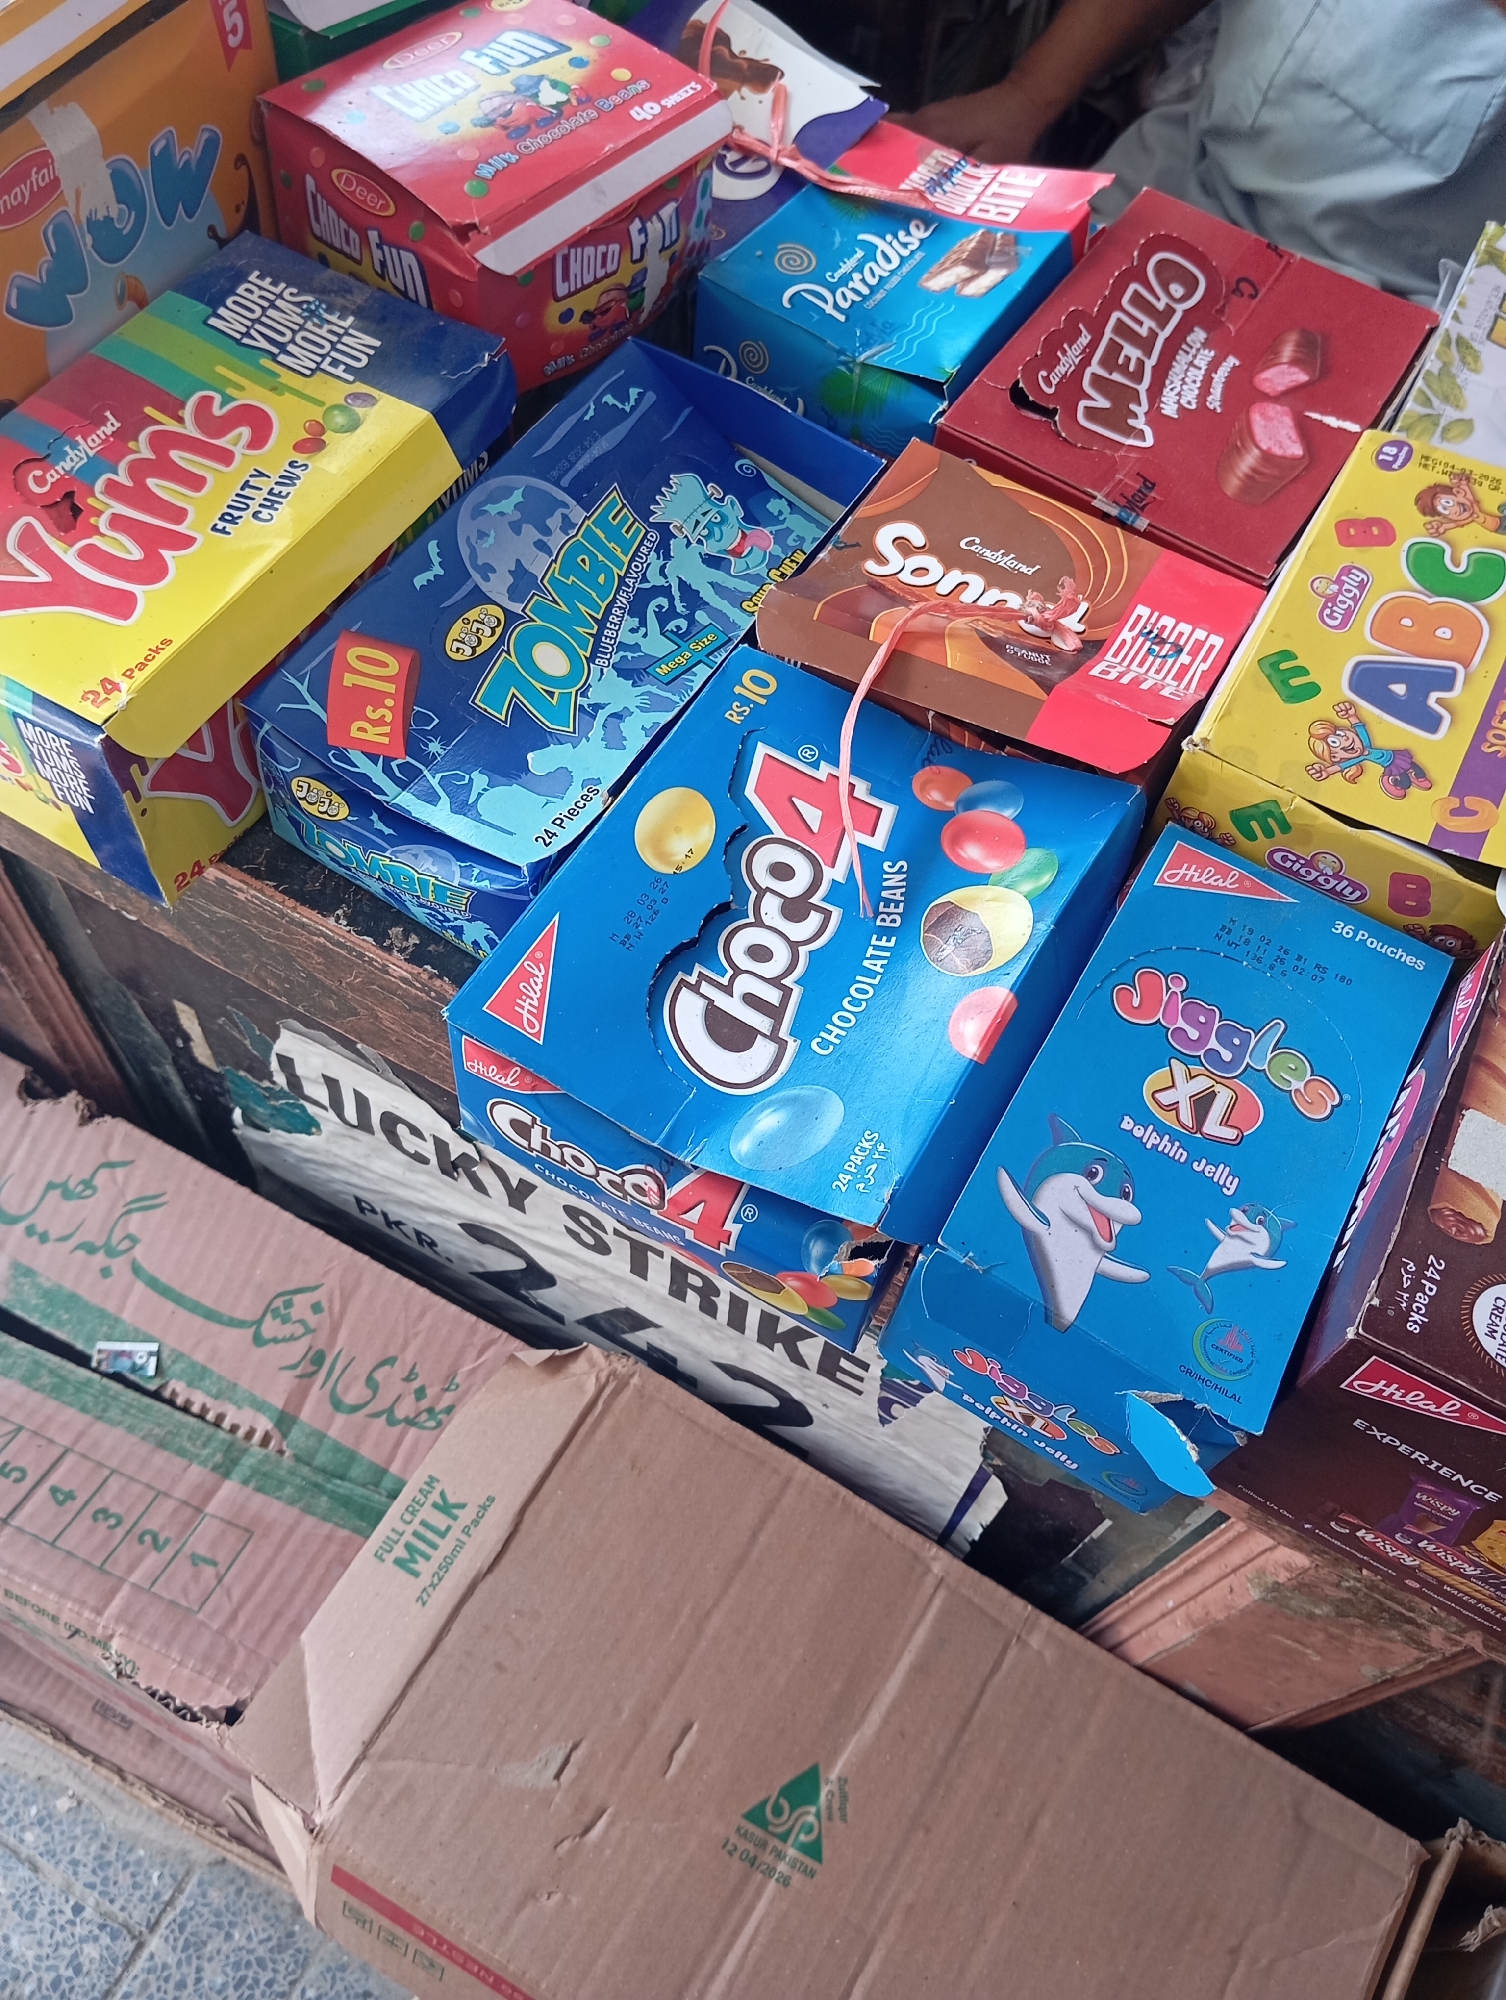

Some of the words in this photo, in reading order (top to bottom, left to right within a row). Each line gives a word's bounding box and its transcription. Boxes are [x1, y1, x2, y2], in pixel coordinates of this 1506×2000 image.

[475, 151, 519, 180] Milk
[516, 108, 599, 155] Chocolate
[594, 79, 651, 112] Beans
[629, 101, 662, 122] 40
[337, 172, 392, 213] Deer
[966, 168, 1048, 224] BITE
[5, 125, 222, 330] WOW
[305, 173, 363, 266] CHOCO
[366, 229, 432, 308] FUN
[554, 242, 622, 300] CHOCO
[782, 219, 939, 323] Paradise
[207, 270, 287, 340] MORE
[242, 287, 314, 356] YUMS
[277, 310, 355, 377] MORE
[321, 329, 382, 382] FUN
[1077, 251, 1206, 448] MELLO
[1378, 445, 1398, 462] 18
[0, 391, 279, 626] Yums
[211, 467, 272, 537] FRUITY
[251, 459, 310, 524] CHEWS
[1333, 516, 1397, 548] B
[470, 484, 650, 735] ZOMBIE
[594, 597, 630, 670] BLUEBERRY
[617, 529, 660, 606] FLAVOURED
[1322, 565, 1369, 628] Giggly
[654, 645, 694, 678] Mega
[690, 630, 718, 657] Size
[1103, 603, 1226, 693] BIGGER
[1342, 536, 1506, 741] ABC
[80, 676, 124, 710] 24
[120, 635, 174, 682] Packs
[343, 645, 401, 746] Rs.10
[1088, 662, 1187, 701] BITE
[1257, 648, 1322, 705] E
[16, 717, 73, 753] MORE
[27, 742, 83, 778] YUMS
[33, 758, 96, 801] MORE
[52, 782, 95, 815] FUN
[534, 822, 559, 850] 24
[554, 784, 601, 829] Pieces
[1229, 799, 1293, 842] E
[1431, 796, 1501, 834] C
[174, 859, 206, 893] 24
[300, 818, 477, 912] ZOMBIE
[1162, 861, 1241, 890] Hilal
[1272, 849, 1365, 906] Giggly
[619, 933, 632, 948] BB
[632, 915, 644, 930] 27
[646, 899, 658, 911] 03
[658, 880, 670, 895] 27
[623, 910, 637, 925] 28
[637, 893, 650, 906] 03
[649, 876, 663, 891] 26
[644, 908, 660, 926] 126
[1386, 872, 1434, 918] B
[809, 931, 899, 1057] CHOCOLATE
[876, 858, 908, 931] BEANS
[1218, 923, 1233, 937] BB
[1237, 934, 1251, 947] 18
[1256, 945, 1268, 956] 11
[1272, 954, 1286, 966] 26
[1292, 964, 1326, 985] 02:07
[1259, 934, 1272, 947] 02
[1277, 945, 1290, 957] 26
[1313, 962, 1329, 975] RS
[1333, 972, 1353, 986] 180
[1331, 920, 1354, 939] 36
[1354, 929, 1427, 972] Pouches
[514, 958, 547, 1037] Hilal
[465, 1056, 521, 1089] Hilal
[1111, 967, 1344, 1122] Jiggles
[1151, 1056, 1244, 1147] XL
[831, 1167, 854, 1193] 24
[847, 1128, 880, 1175] PACKS
[1119, 1114, 1189, 1166] Dolphin
[1191, 1156, 1241, 1198] Jelly
[277, 1052, 539, 1213] LUCKY
[562, 1203, 872, 1397] STRIKE
[350, 1193, 455, 1266] PKR.
[533, 1162, 630, 1221] CHOCOLATE
[631, 1216, 686, 1247] BEANS
[1424, 1253, 1446, 1282] 24
[1405, 1278, 1438, 1335] Packs
[1484, 1295, 1506, 1341] CREAM
[1210, 1343, 1245, 1364] CERTIFIED
[952, 1347, 1120, 1455] Jiggles
[1178, 1363, 1243, 1405] CR/IHC/HILAL
[1351, 1371, 1465, 1421] Hilal
[962, 1393, 1029, 1438] Dolphin
[1033, 1438, 1080, 1471] Jelly
[1352, 1417, 1503, 1503] EXPERIENCE
[48, 1484, 79, 1509] 4
[91, 1505, 126, 1531] 3
[374, 1516, 405, 1563] FULL
[401, 1473, 441, 1527] CREAM
[1237, 1484, 1266, 1503] Follow
[136, 1527, 173, 1554] 2
[392, 1488, 470, 1580] MILK
[415, 1537, 465, 1609] 27x250ml
[460, 1491, 497, 1542] Packs
[4, 1587, 61, 1626] BEFORE
[1442, 1584, 1477, 1606] WAFER
[734, 1823, 770, 1851] KASUR
[769, 1844, 818, 1881] PAKISTAN
